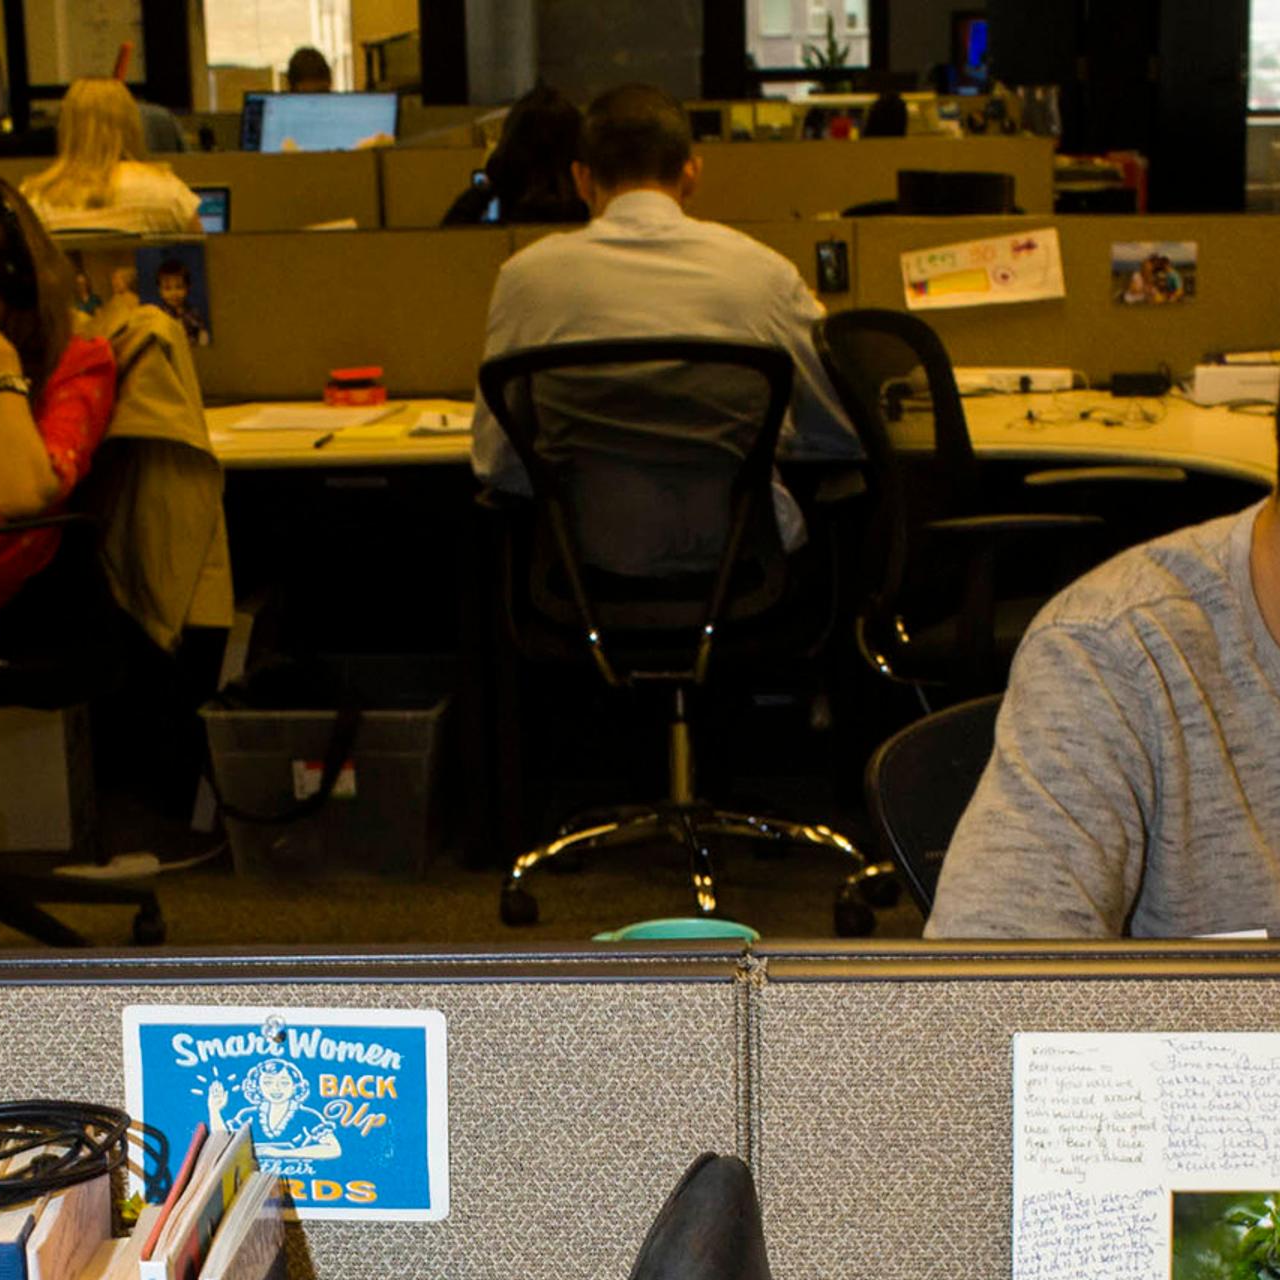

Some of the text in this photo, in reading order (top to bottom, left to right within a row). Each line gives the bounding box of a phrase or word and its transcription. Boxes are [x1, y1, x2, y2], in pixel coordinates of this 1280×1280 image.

[172, 1026, 402, 1070] Smart Women
[319, 1074, 398, 1099] BACK
[324, 1100, 387, 1136] Up
[260, 1159, 317, 1176] their
